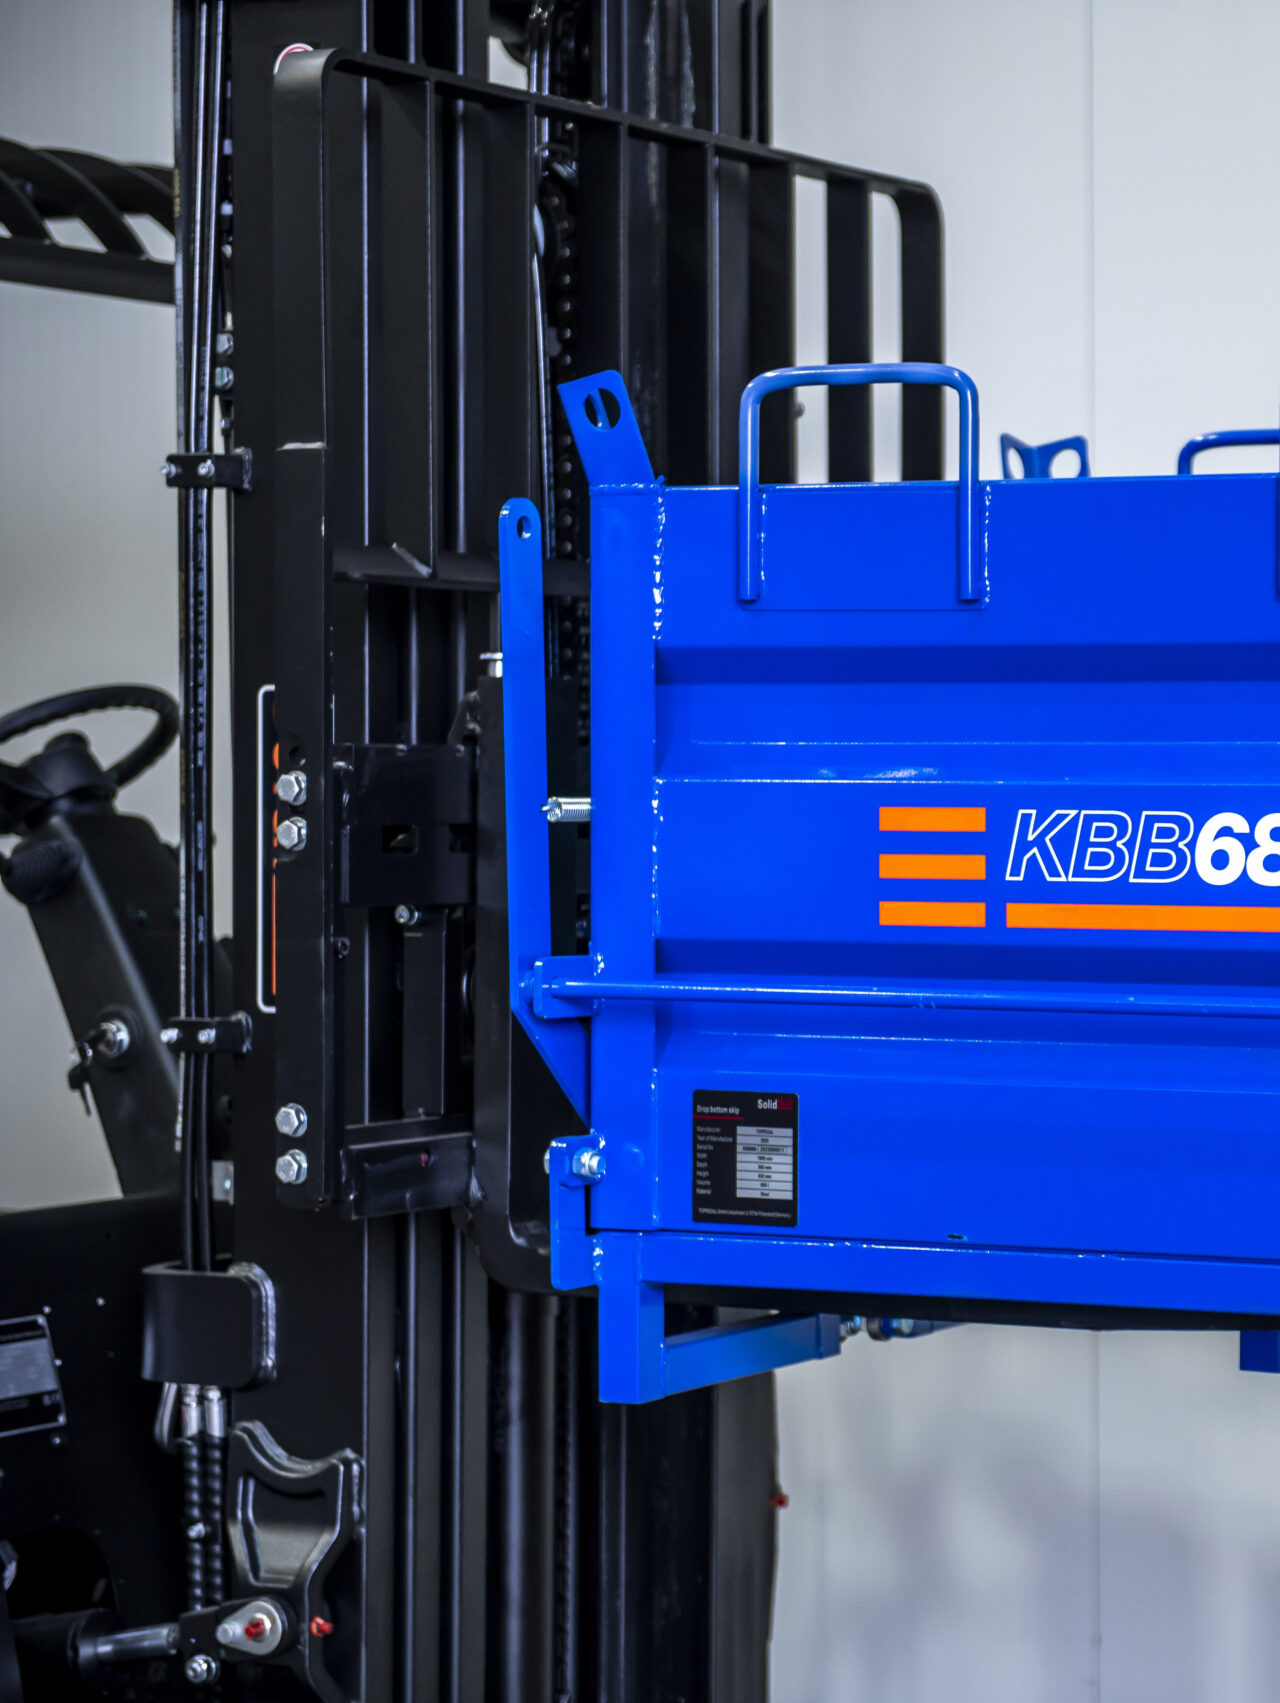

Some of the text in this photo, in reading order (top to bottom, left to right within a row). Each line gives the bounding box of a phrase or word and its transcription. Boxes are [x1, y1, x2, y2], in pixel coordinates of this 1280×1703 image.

[697, 1104, 740, 1116] Drop bottom skip
